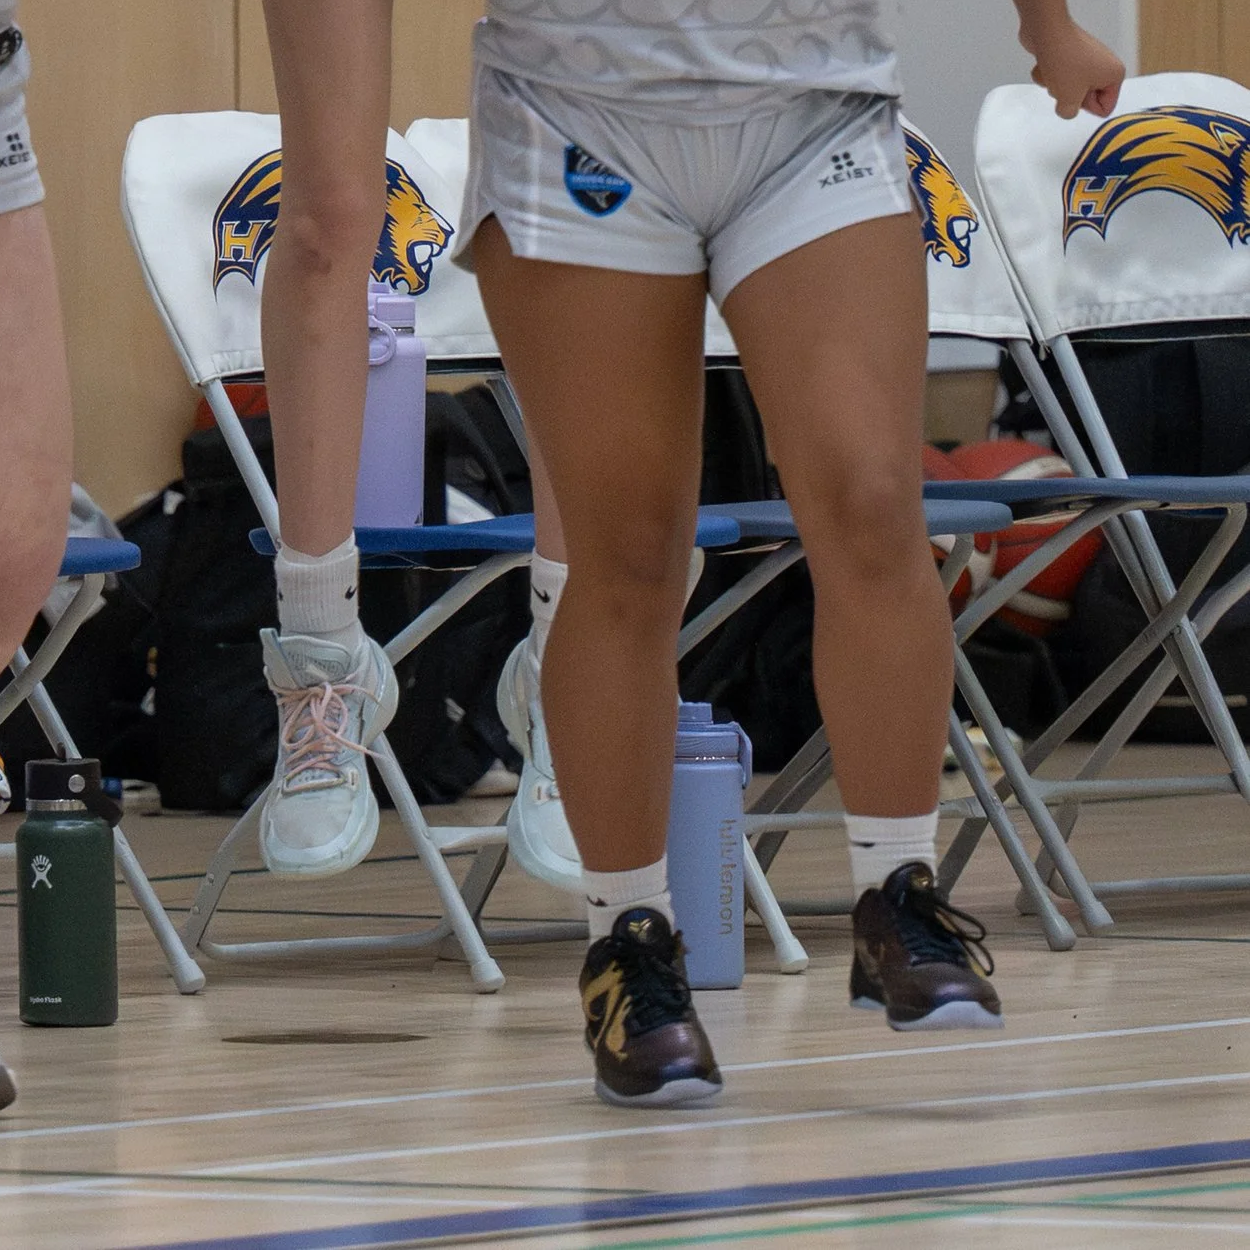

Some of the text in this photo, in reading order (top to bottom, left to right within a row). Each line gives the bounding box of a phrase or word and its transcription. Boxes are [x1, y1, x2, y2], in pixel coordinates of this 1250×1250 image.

[818, 167, 874, 189] XEIST
[1068, 175, 1130, 219] H
[219, 219, 273, 262] H
[719, 817, 737, 935] lululemon
